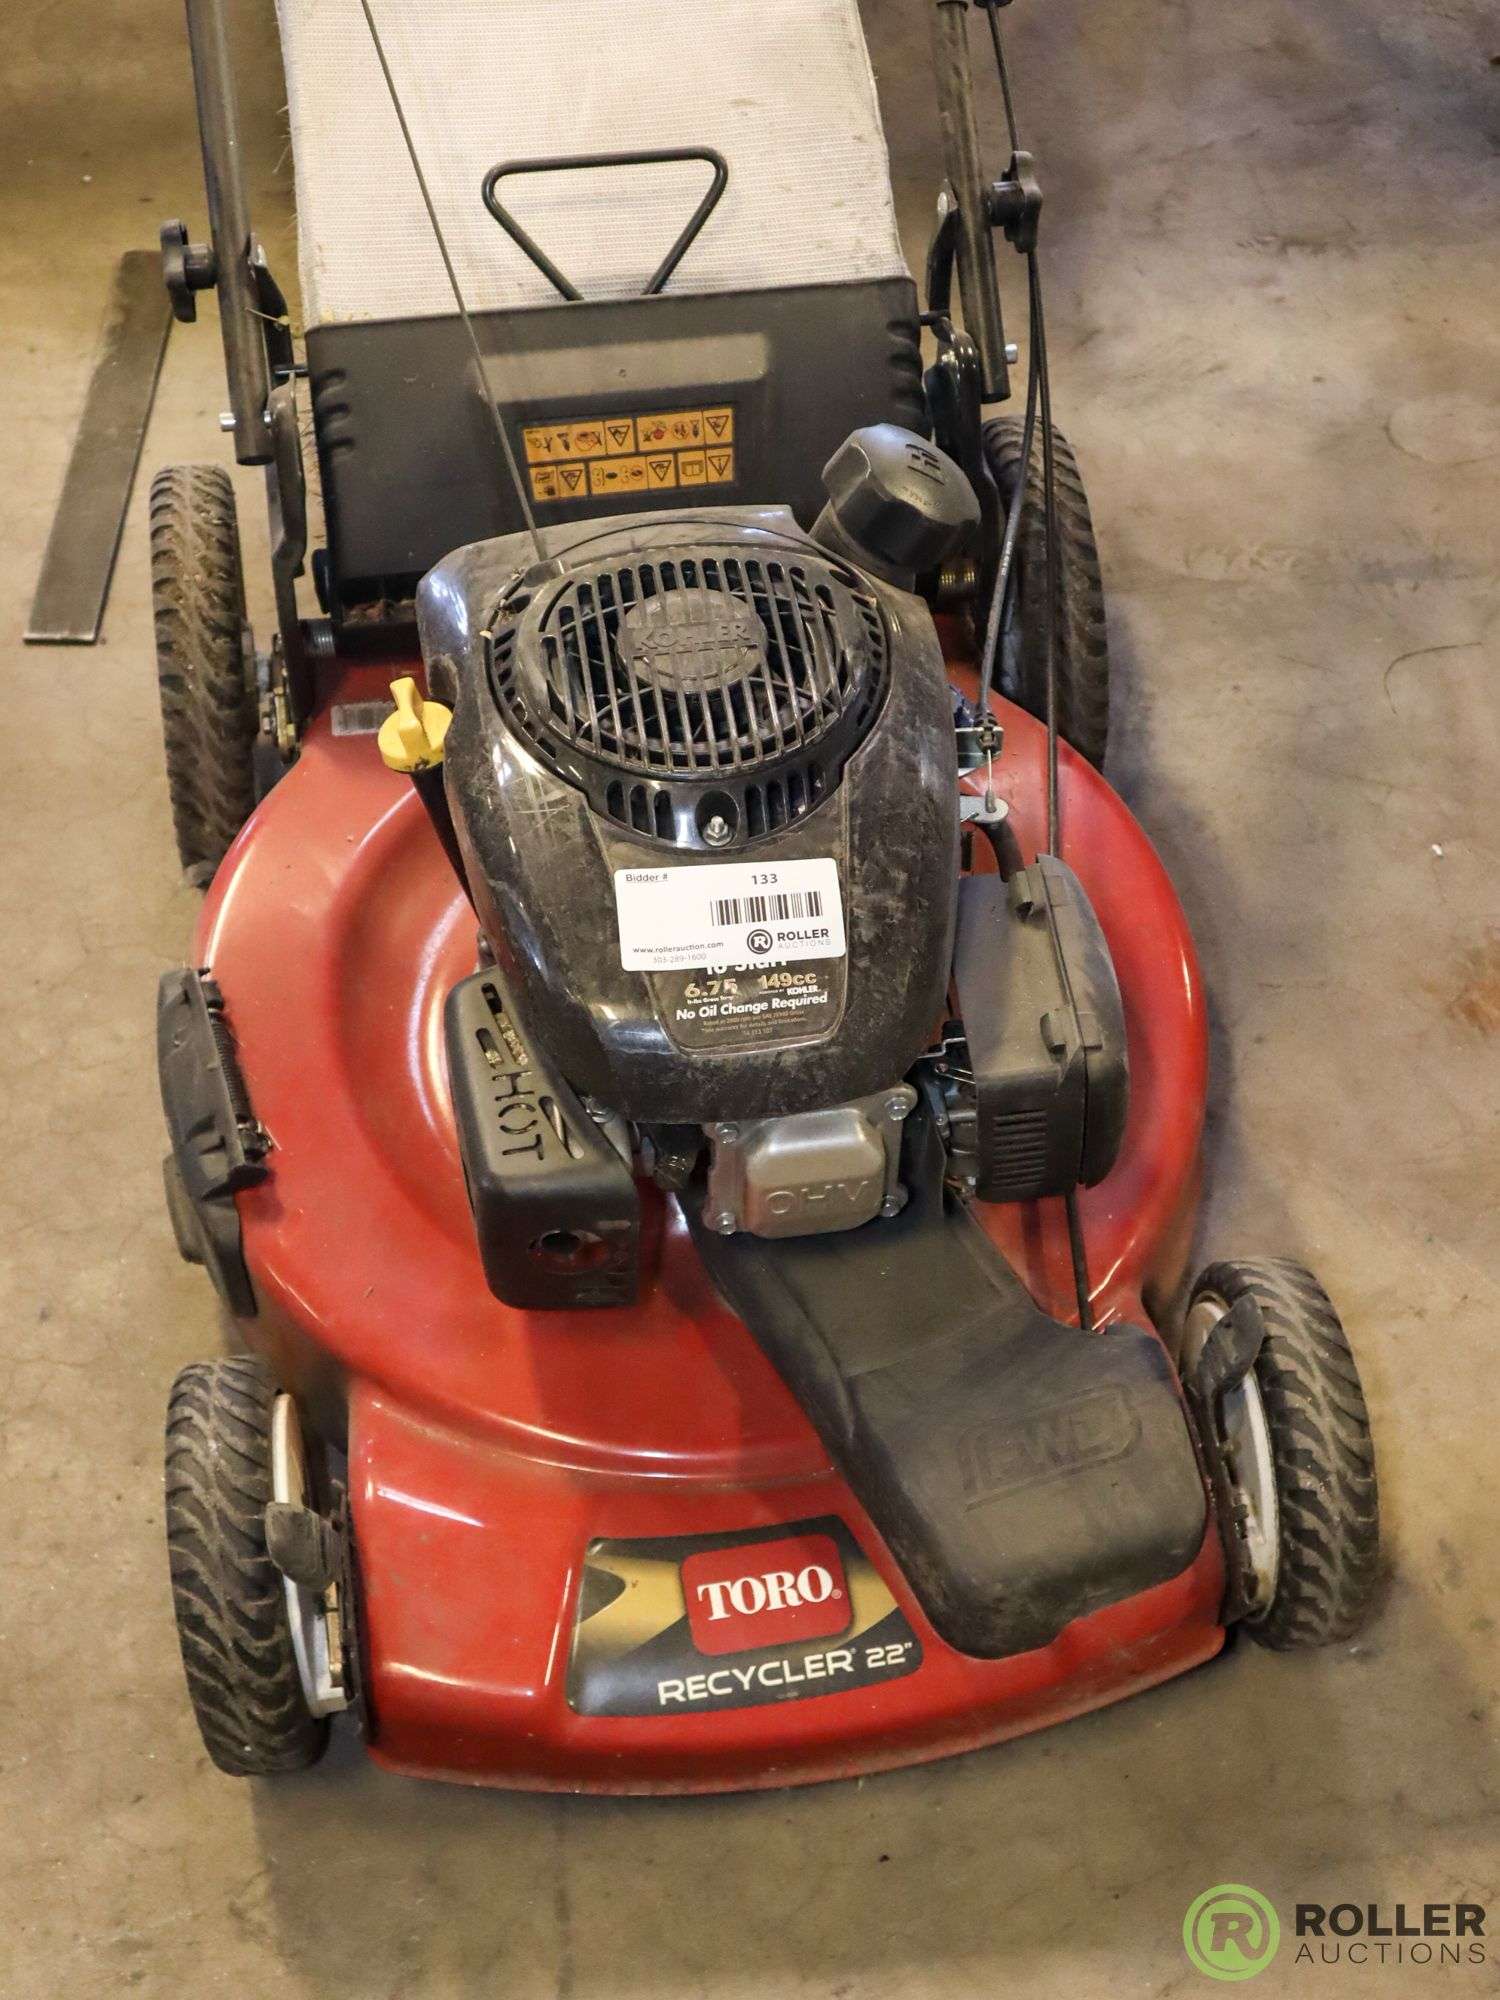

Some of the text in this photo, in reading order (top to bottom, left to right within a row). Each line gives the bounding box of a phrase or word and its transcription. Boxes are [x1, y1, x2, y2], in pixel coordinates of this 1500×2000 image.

[625, 873, 659, 882] Bidder
[751, 873, 778, 885] 133
[777, 928, 830, 942] ROLLER
[632, 941, 724, 953] www.rollerauction.com
[684, 972, 817, 998] 6.75 149cc
[676, 1008, 696, 1020] No
[698, 1004, 717, 1018] Oil
[720, 999, 768, 1015] Change
[771, 991, 828, 1010] Required
[492, 1070, 545, 1161] HOT
[657, 1642, 913, 1706] RECYCLER 22"
